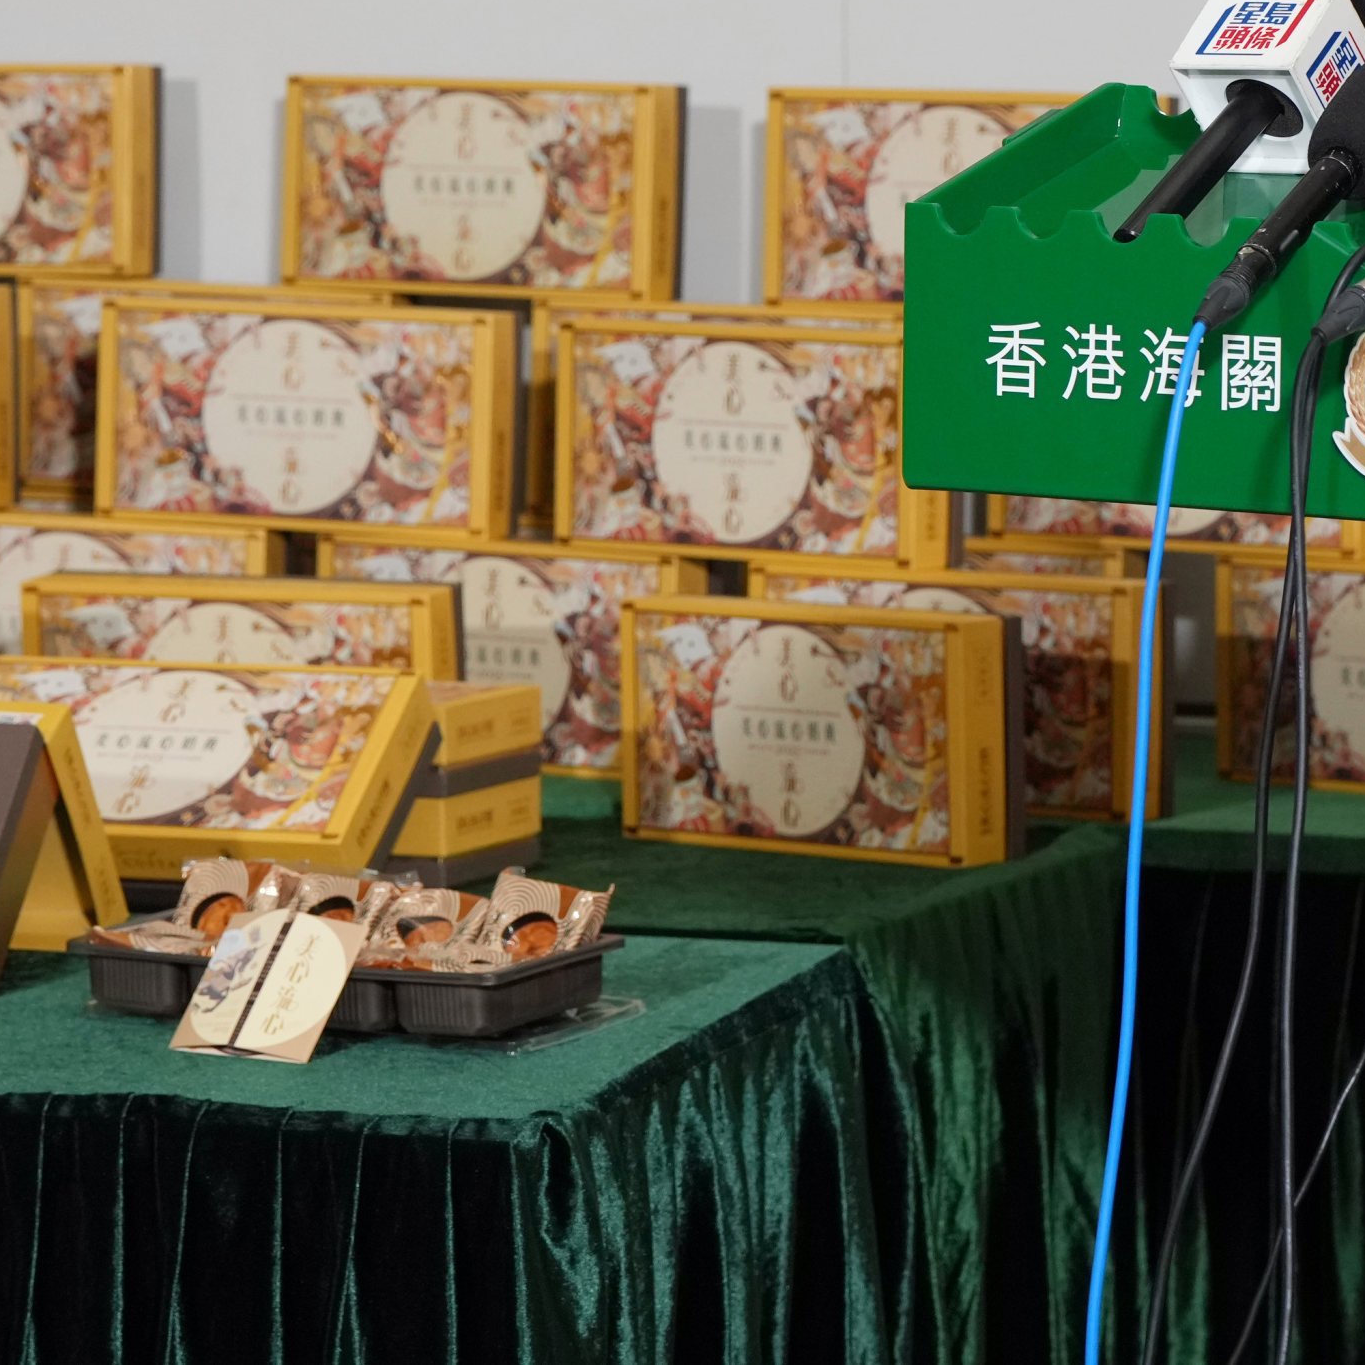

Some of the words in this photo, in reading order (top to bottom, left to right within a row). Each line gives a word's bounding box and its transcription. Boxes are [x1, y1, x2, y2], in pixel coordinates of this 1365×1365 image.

[1229, 0, 1297, 26] 星島
[1212, 25, 1279, 51] 頭條
[985, 321, 1282, 412] 香港海關
